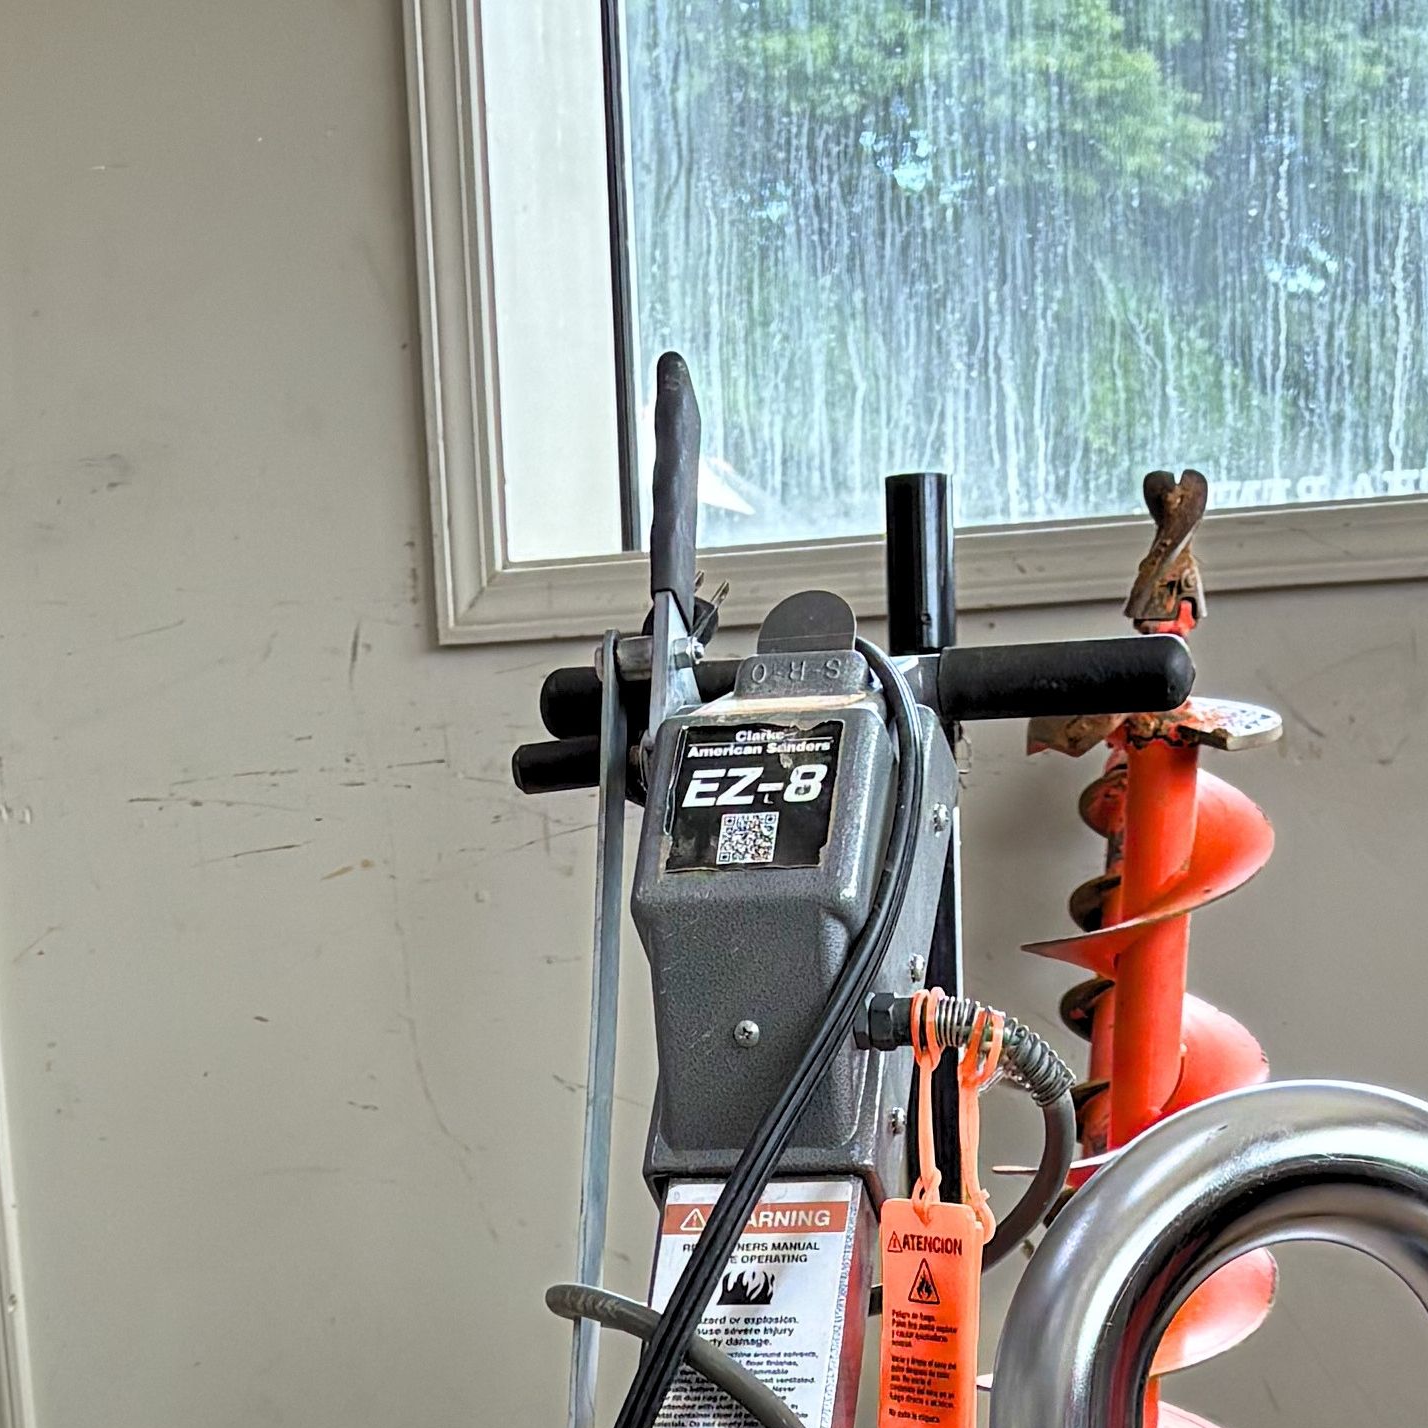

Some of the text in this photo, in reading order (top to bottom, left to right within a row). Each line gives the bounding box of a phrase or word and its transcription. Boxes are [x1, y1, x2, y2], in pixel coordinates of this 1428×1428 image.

[687, 744, 762, 758] American
[681, 764, 828, 808] EZ-8
[744, 1210, 830, 1228] ARNING
[772, 1242, 820, 1251] MANUAL
[902, 1233, 963, 1256] ATENCION
[741, 1254, 808, 1264] OPERATING
